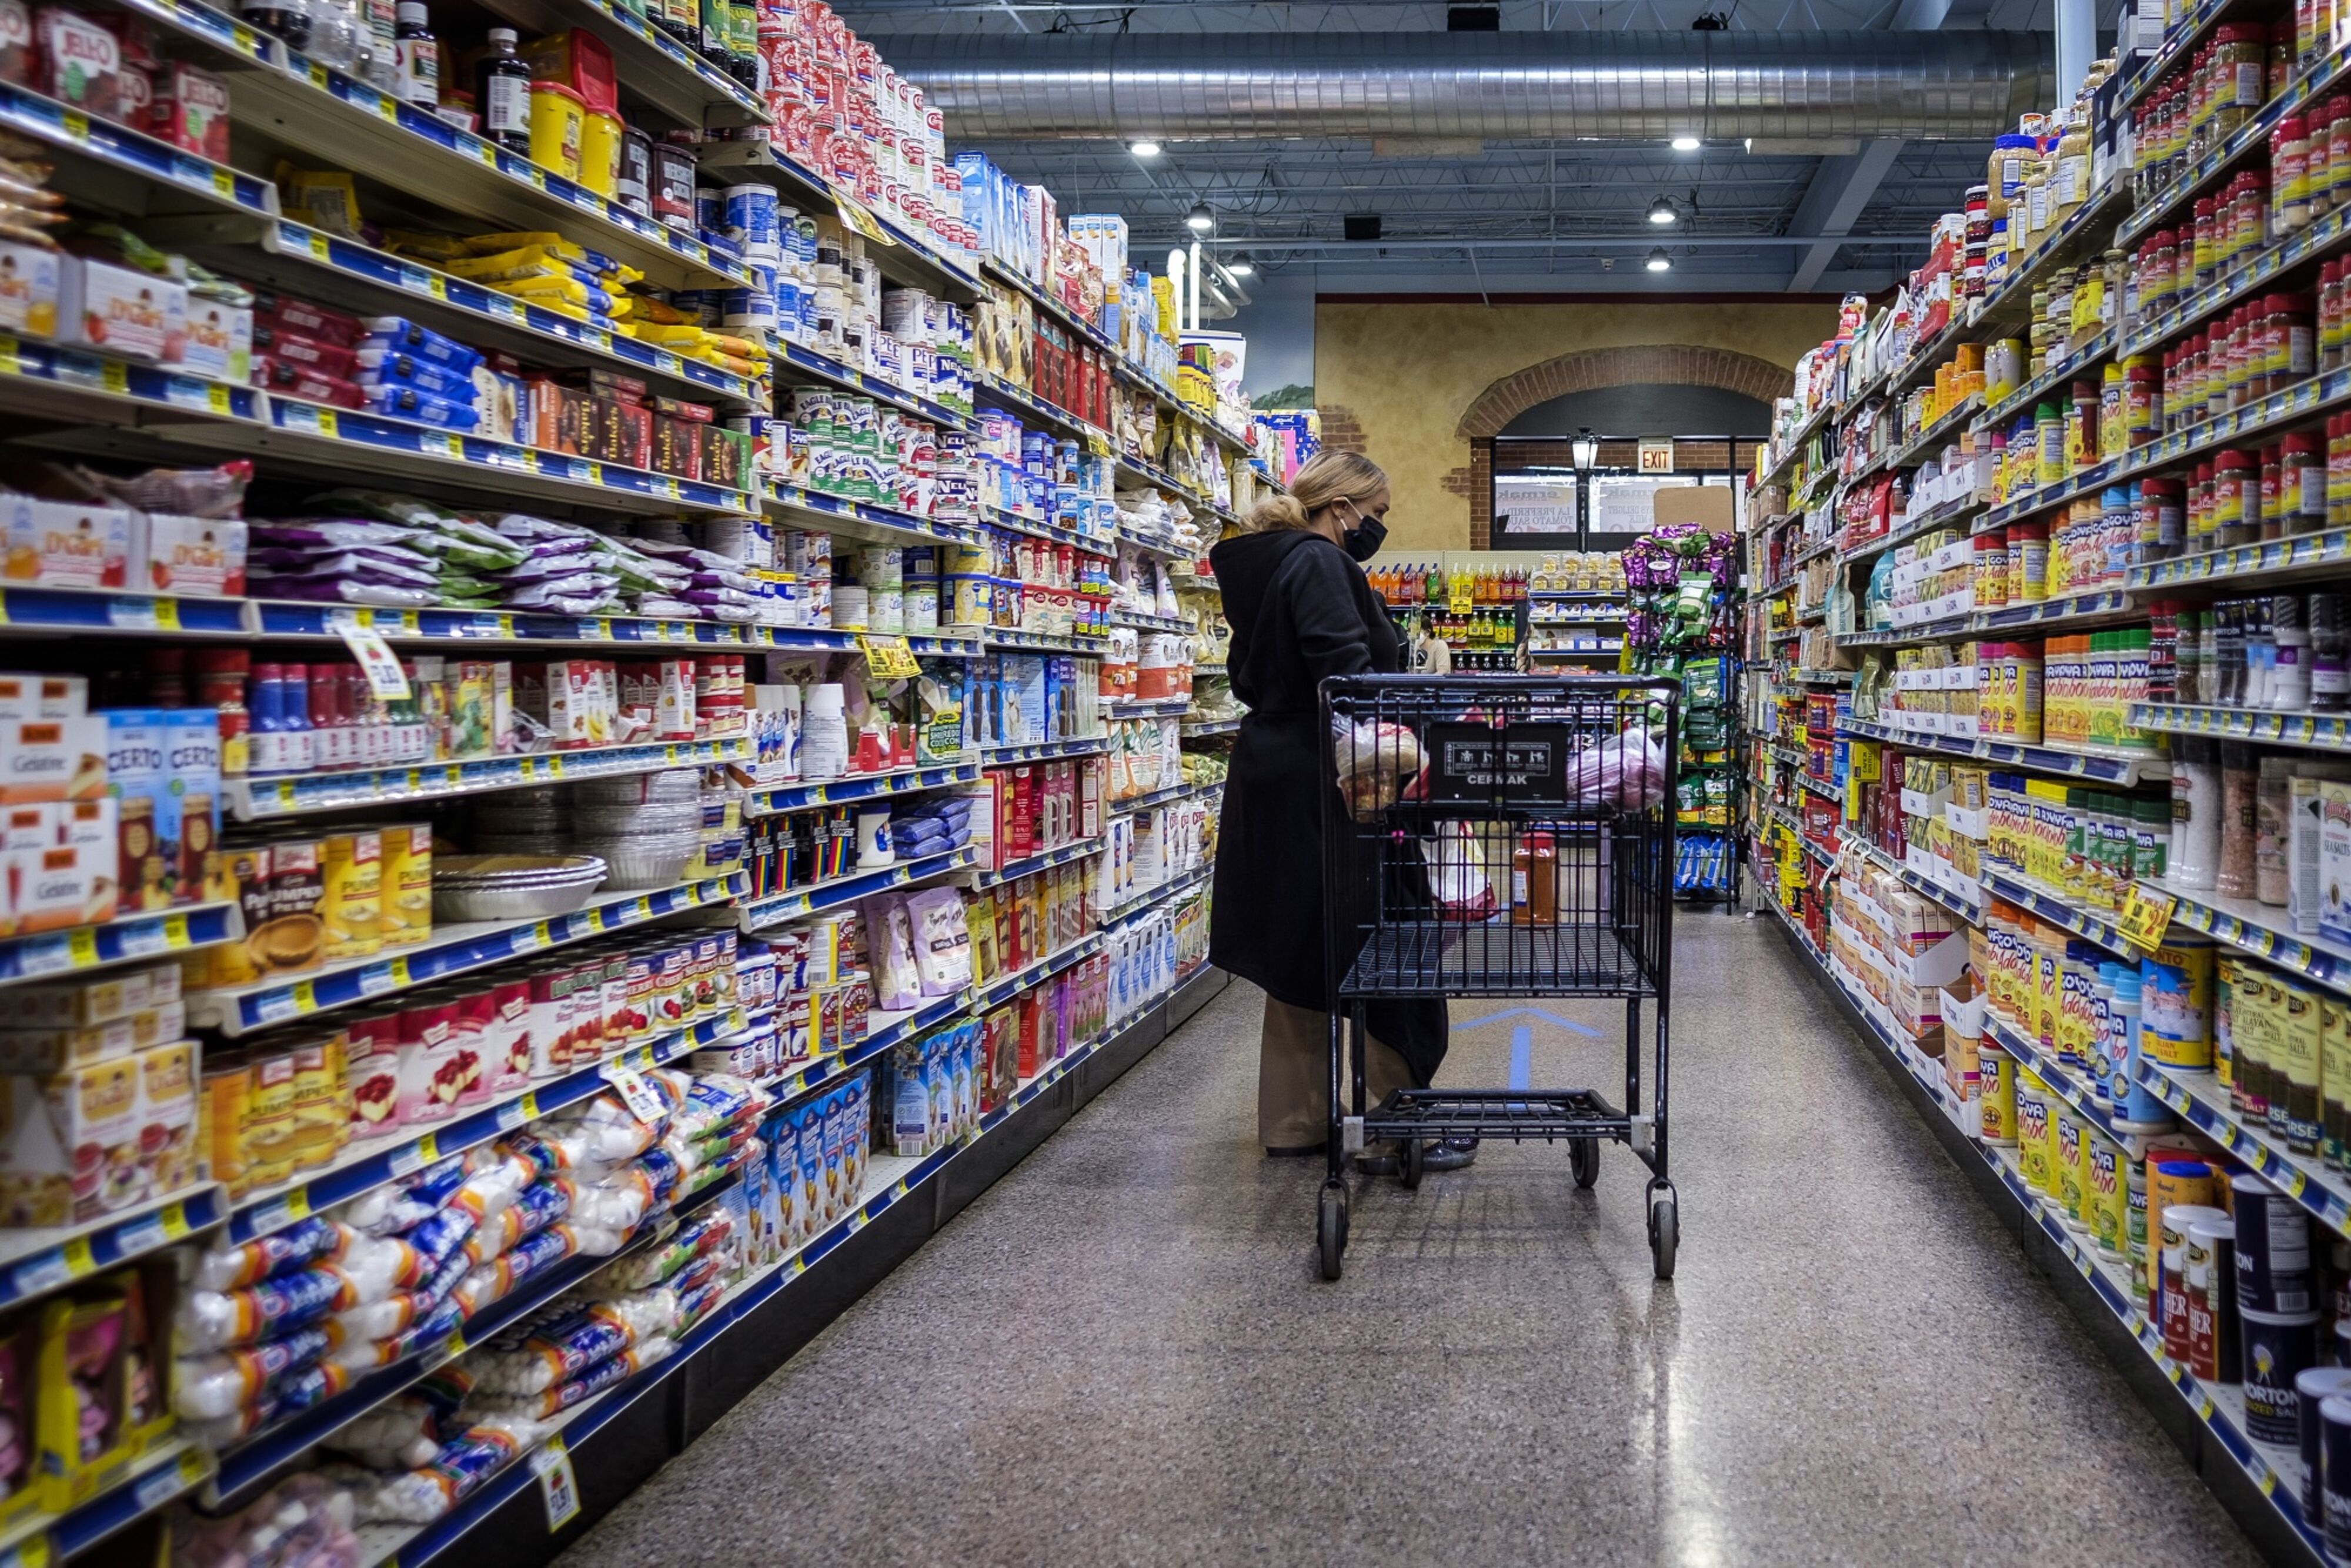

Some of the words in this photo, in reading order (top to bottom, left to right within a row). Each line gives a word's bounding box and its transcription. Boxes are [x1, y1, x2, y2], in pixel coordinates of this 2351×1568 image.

[1987, 255, 2002, 271] LIC
[800, 394, 826, 411] EAGLE
[1642, 451, 1669, 469] EXIT
[108, 748, 162, 773] CERTO
